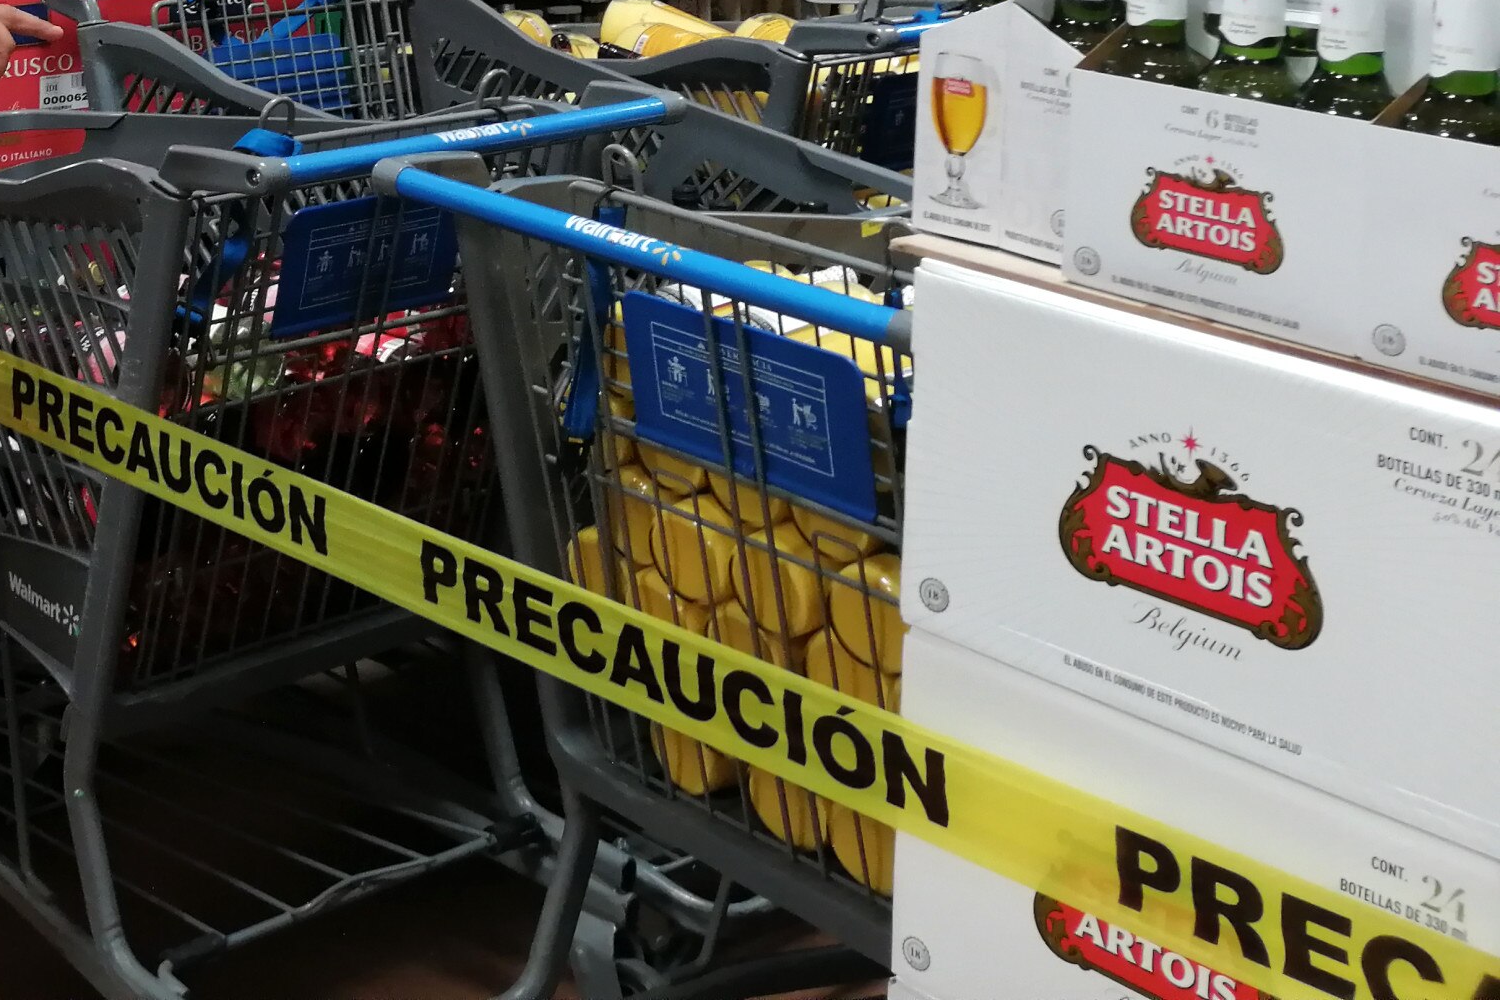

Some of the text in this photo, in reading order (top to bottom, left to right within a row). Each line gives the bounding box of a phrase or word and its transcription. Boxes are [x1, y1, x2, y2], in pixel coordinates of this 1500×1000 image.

[437, 122, 509, 143] Walmart
[1205, 110, 1219, 129] 6
[11, 148, 52, 160] ITALIANO
[1159, 190, 1256, 229] STELLA
[565, 214, 657, 252] Walmart
[1156, 213, 1256, 252] ARTOIS
[1174, 258, 1239, 285] Belgium
[1128, 431, 1173, 451] ANNO
[1409, 427, 1448, 449] CONT.
[11, 366, 330, 556] PRECAUCIÓN
[1377, 453, 1490, 497] BOTELLAS DE 330
[1394, 478, 1458, 507] Cerveza
[1105, 483, 1274, 570] STELLA
[1100, 523, 1274, 610] ARTOIS
[8, 570, 63, 624] Walmart
[1131, 600, 1244, 662] Belgium
[419, 540, 950, 828] PRECAUCIÓN
[1174, 698, 1210, 720] PRODUCTO
[1370, 856, 1408, 883] CONT.
[1339, 878, 1449, 934] BOTELLAS DE 330
[1074, 913, 1238, 1000] ARTOIS
